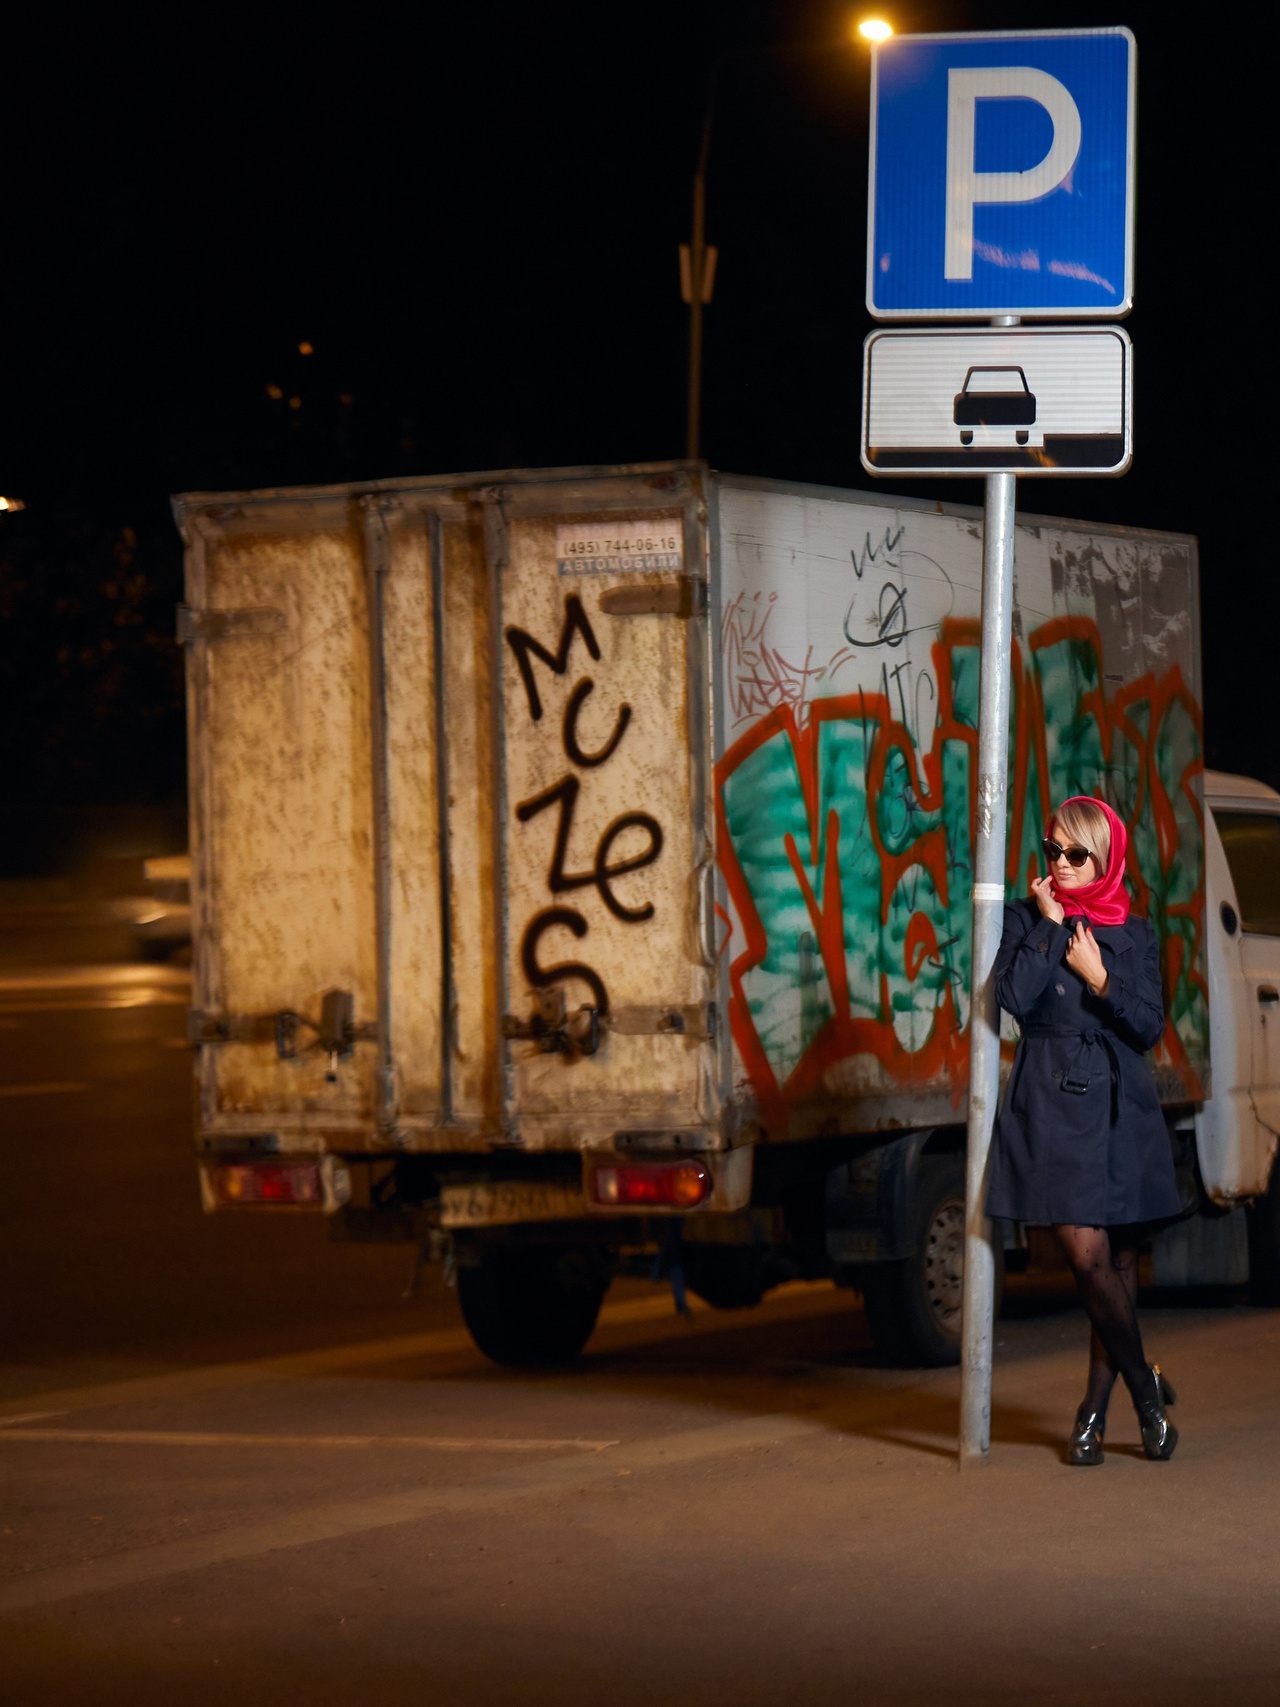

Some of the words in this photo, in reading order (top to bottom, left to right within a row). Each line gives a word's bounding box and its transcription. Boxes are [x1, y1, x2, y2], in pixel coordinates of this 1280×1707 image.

[944, 66, 1082, 281] P
[563, 541, 599, 556] (495)
[604, 537, 676, 552] 744-06-16
[562, 554, 679, 572] АВТОМОБИЛИ
